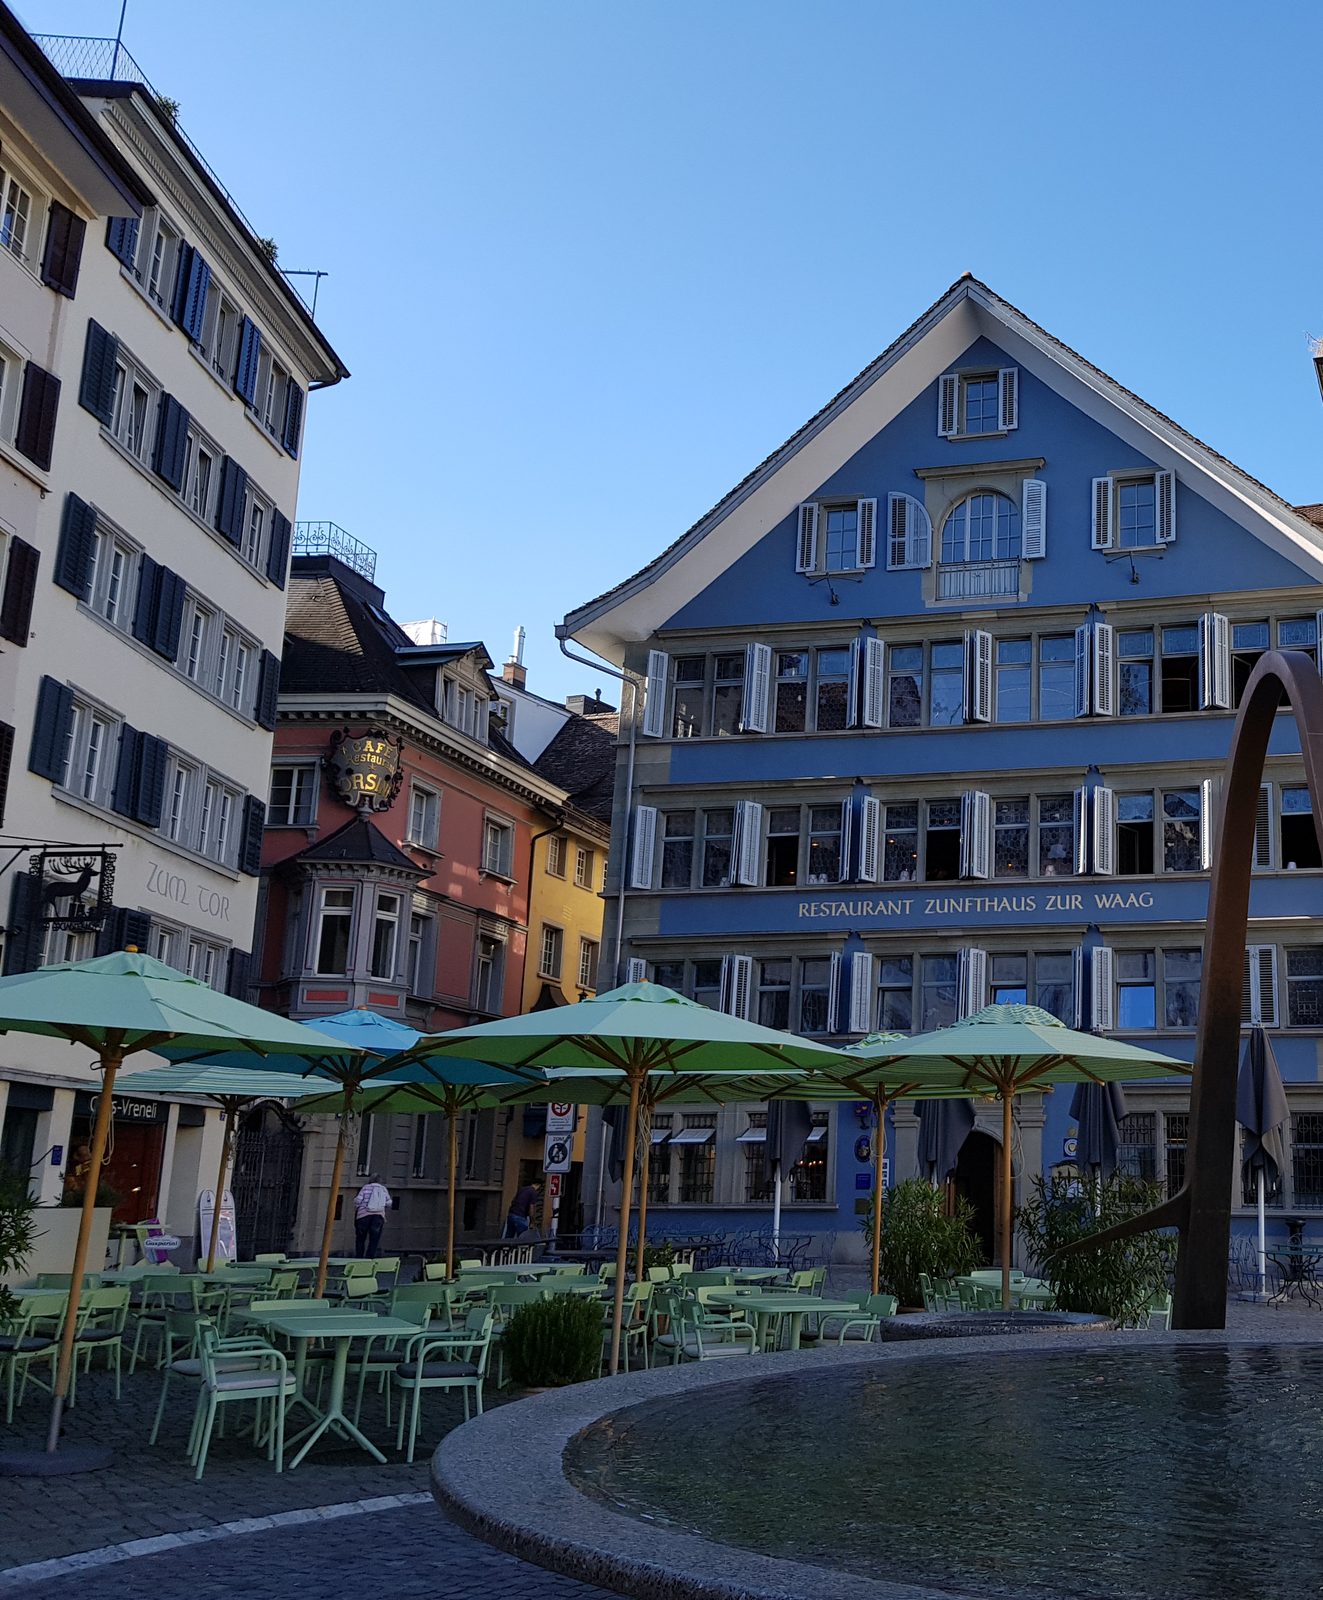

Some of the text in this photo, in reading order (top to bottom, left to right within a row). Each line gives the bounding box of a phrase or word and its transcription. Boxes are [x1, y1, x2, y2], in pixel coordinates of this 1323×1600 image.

[146, 861, 230, 921] ZUM TOR
[799, 891, 1154, 917] RESTAURANT ZUNFTHAUS ZUR WAAG
[90, 1095, 157, 1119] Cs-Vreneli
